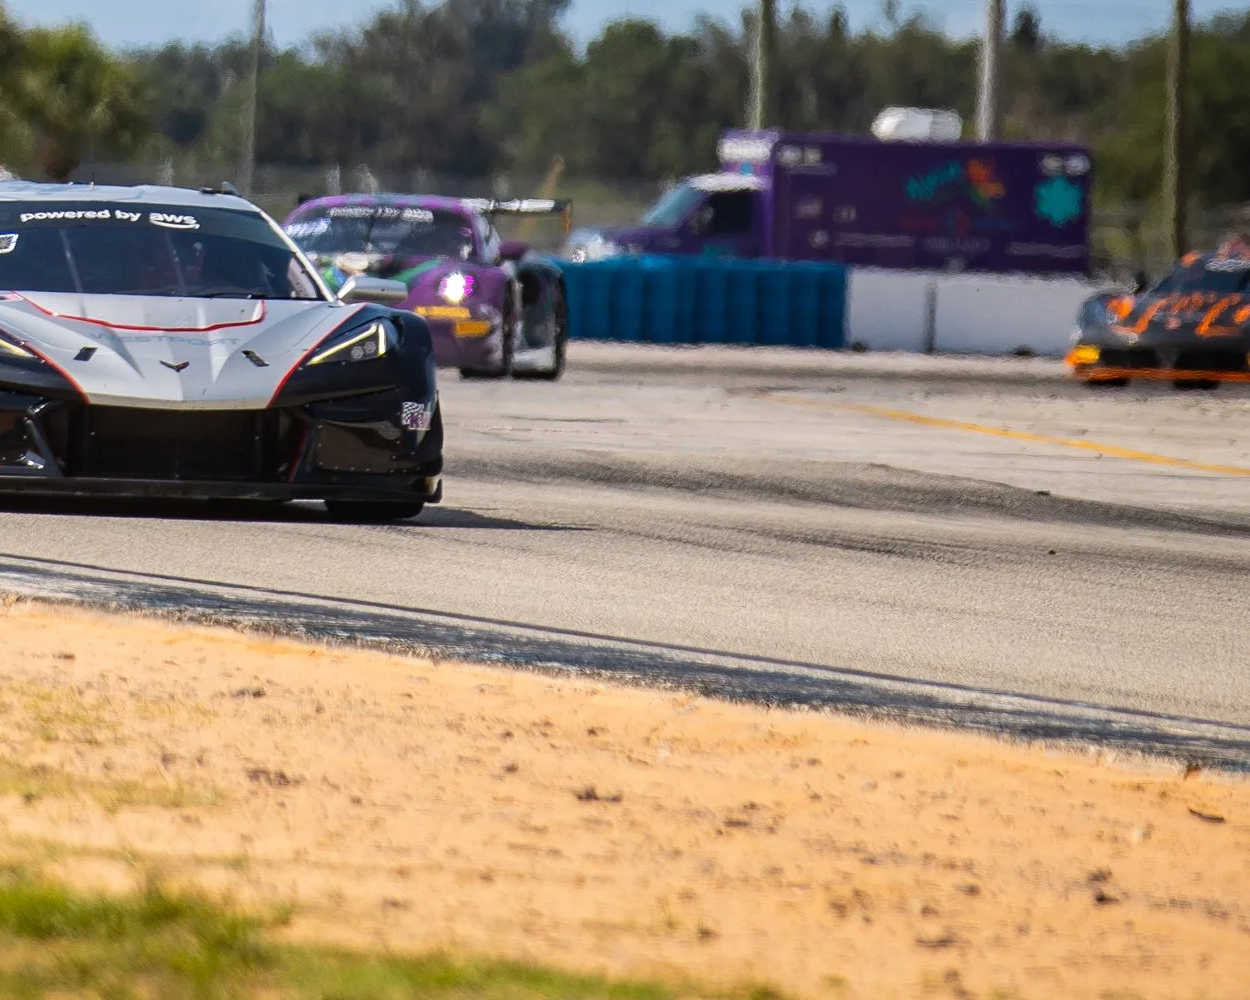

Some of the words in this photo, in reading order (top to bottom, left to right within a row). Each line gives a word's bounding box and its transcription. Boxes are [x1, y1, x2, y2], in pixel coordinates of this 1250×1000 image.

[20, 209, 111, 222] powered
[115, 210, 141, 222] by
[149, 212, 199, 228] aws
